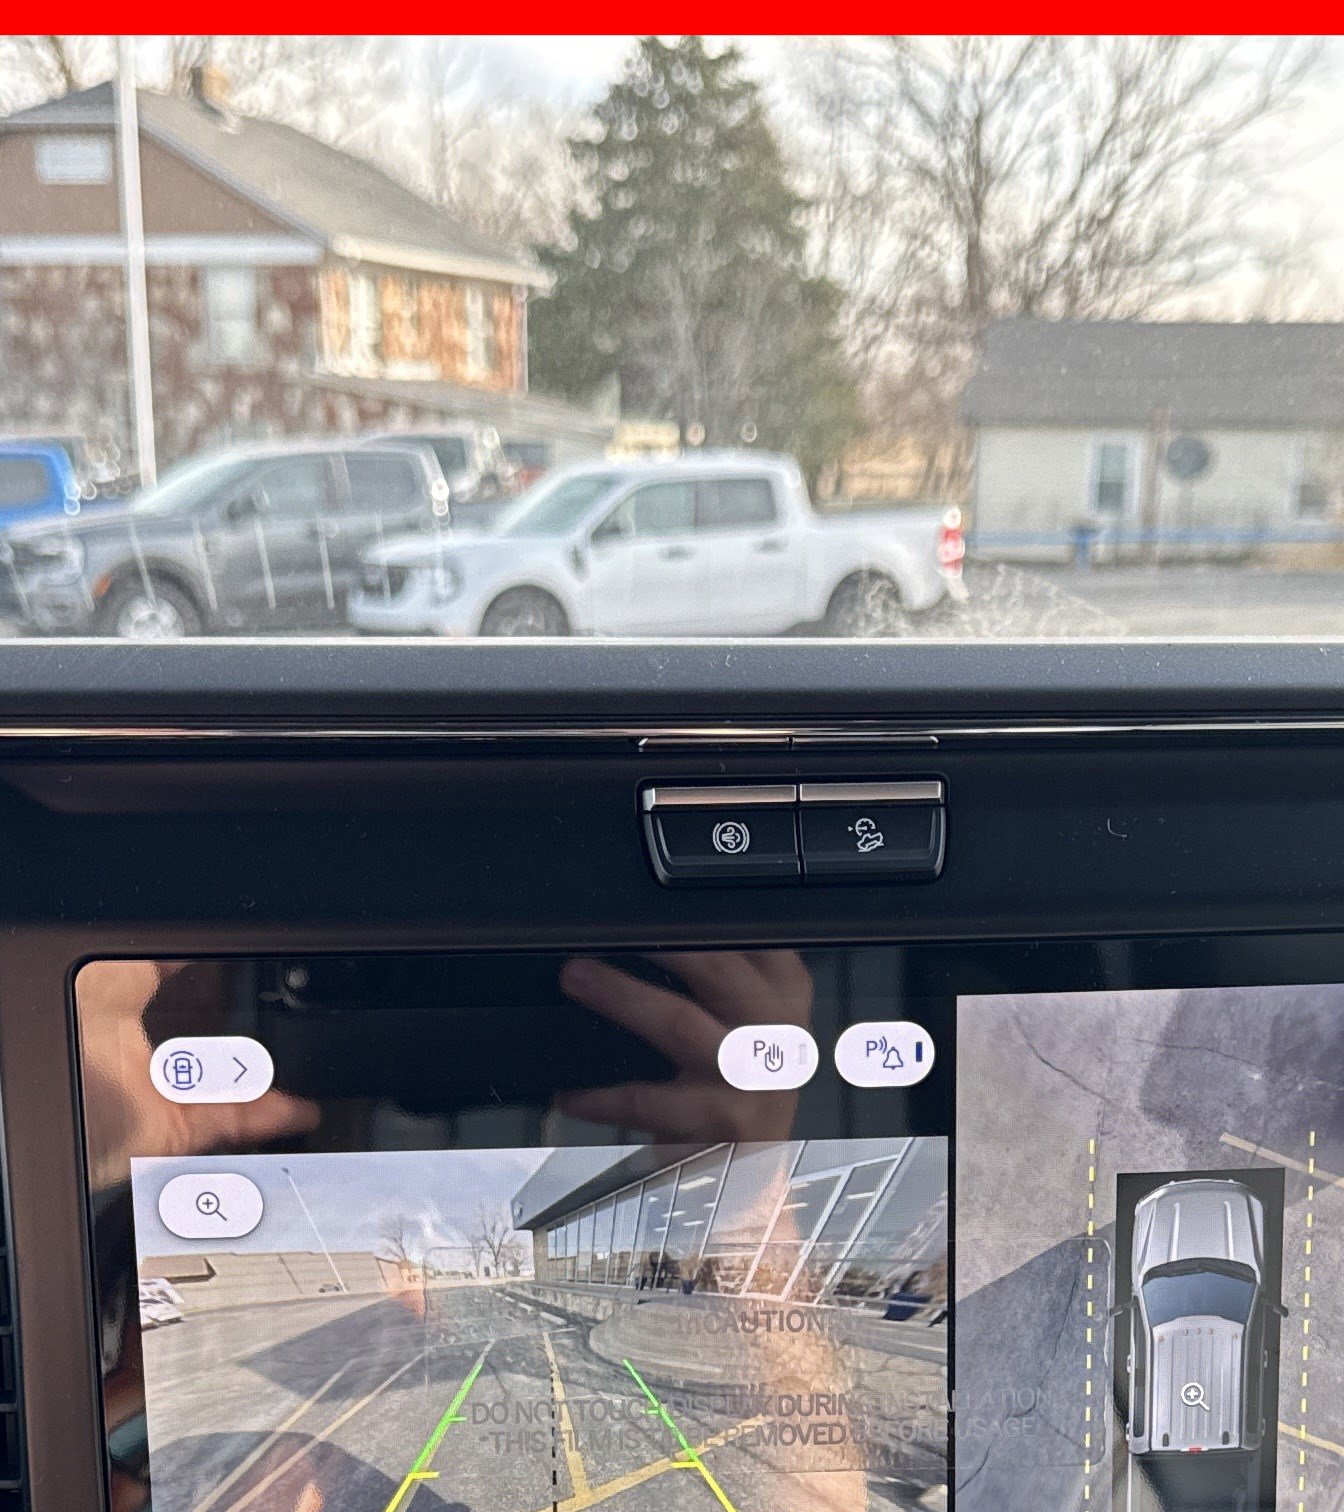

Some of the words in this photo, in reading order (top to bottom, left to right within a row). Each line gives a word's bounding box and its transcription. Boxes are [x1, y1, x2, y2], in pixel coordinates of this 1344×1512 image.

[705, 1309, 826, 1334] CAUTION
[472, 1402, 506, 1425] DO
[667, 1395, 771, 1422] DISPLY
